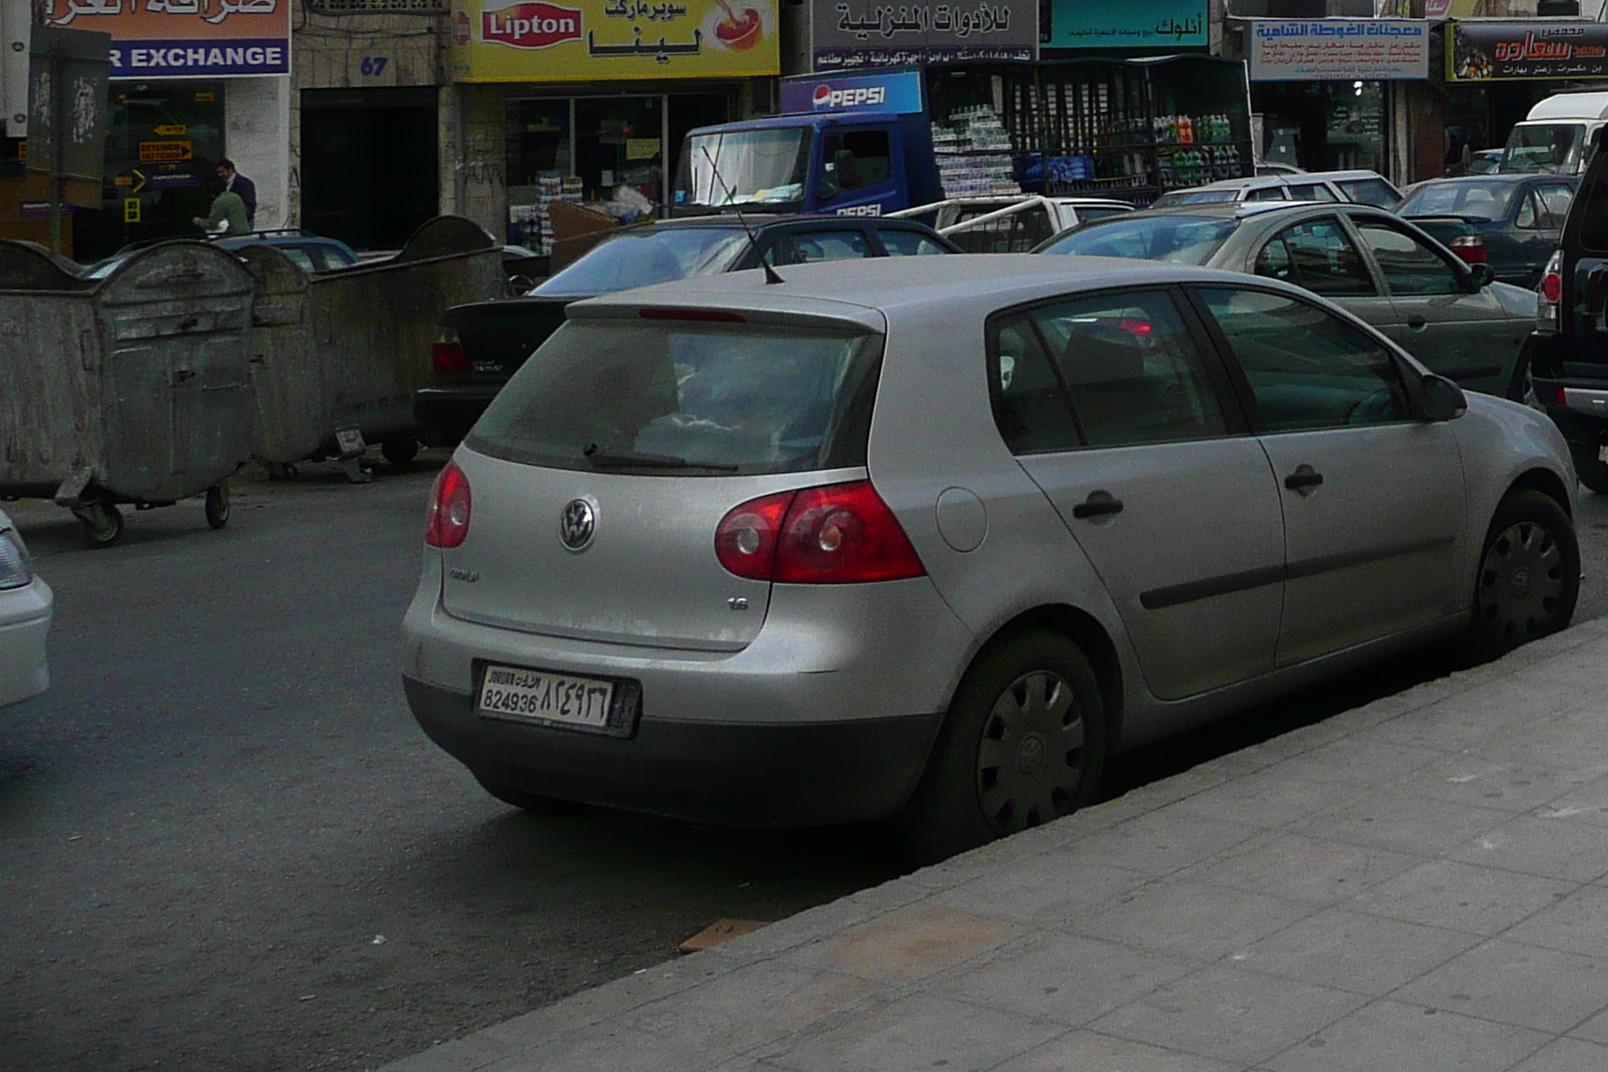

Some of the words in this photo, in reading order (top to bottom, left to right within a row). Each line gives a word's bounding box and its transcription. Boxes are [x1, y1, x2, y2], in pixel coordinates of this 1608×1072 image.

[489, 14, 575, 40] Lipton
[835, 3, 929, 40] المنزلية
[933, 1, 1011, 37] للأدوات
[1257, 22, 1308, 41] الشامية
[1310, 23, 1365, 39] الغوطة
[1367, 23, 1422, 39] معجنات
[588, 26, 702, 64] لينا
[109, 50, 122, 67] R
[131, 47, 282, 67] EXCHANGE
[361, 57, 388, 76] 67
[830, 87, 885, 107] PEPSI
[484, 689, 538, 713] 824936
[541, 679, 608, 719] ٨٢٤٩٣٦
